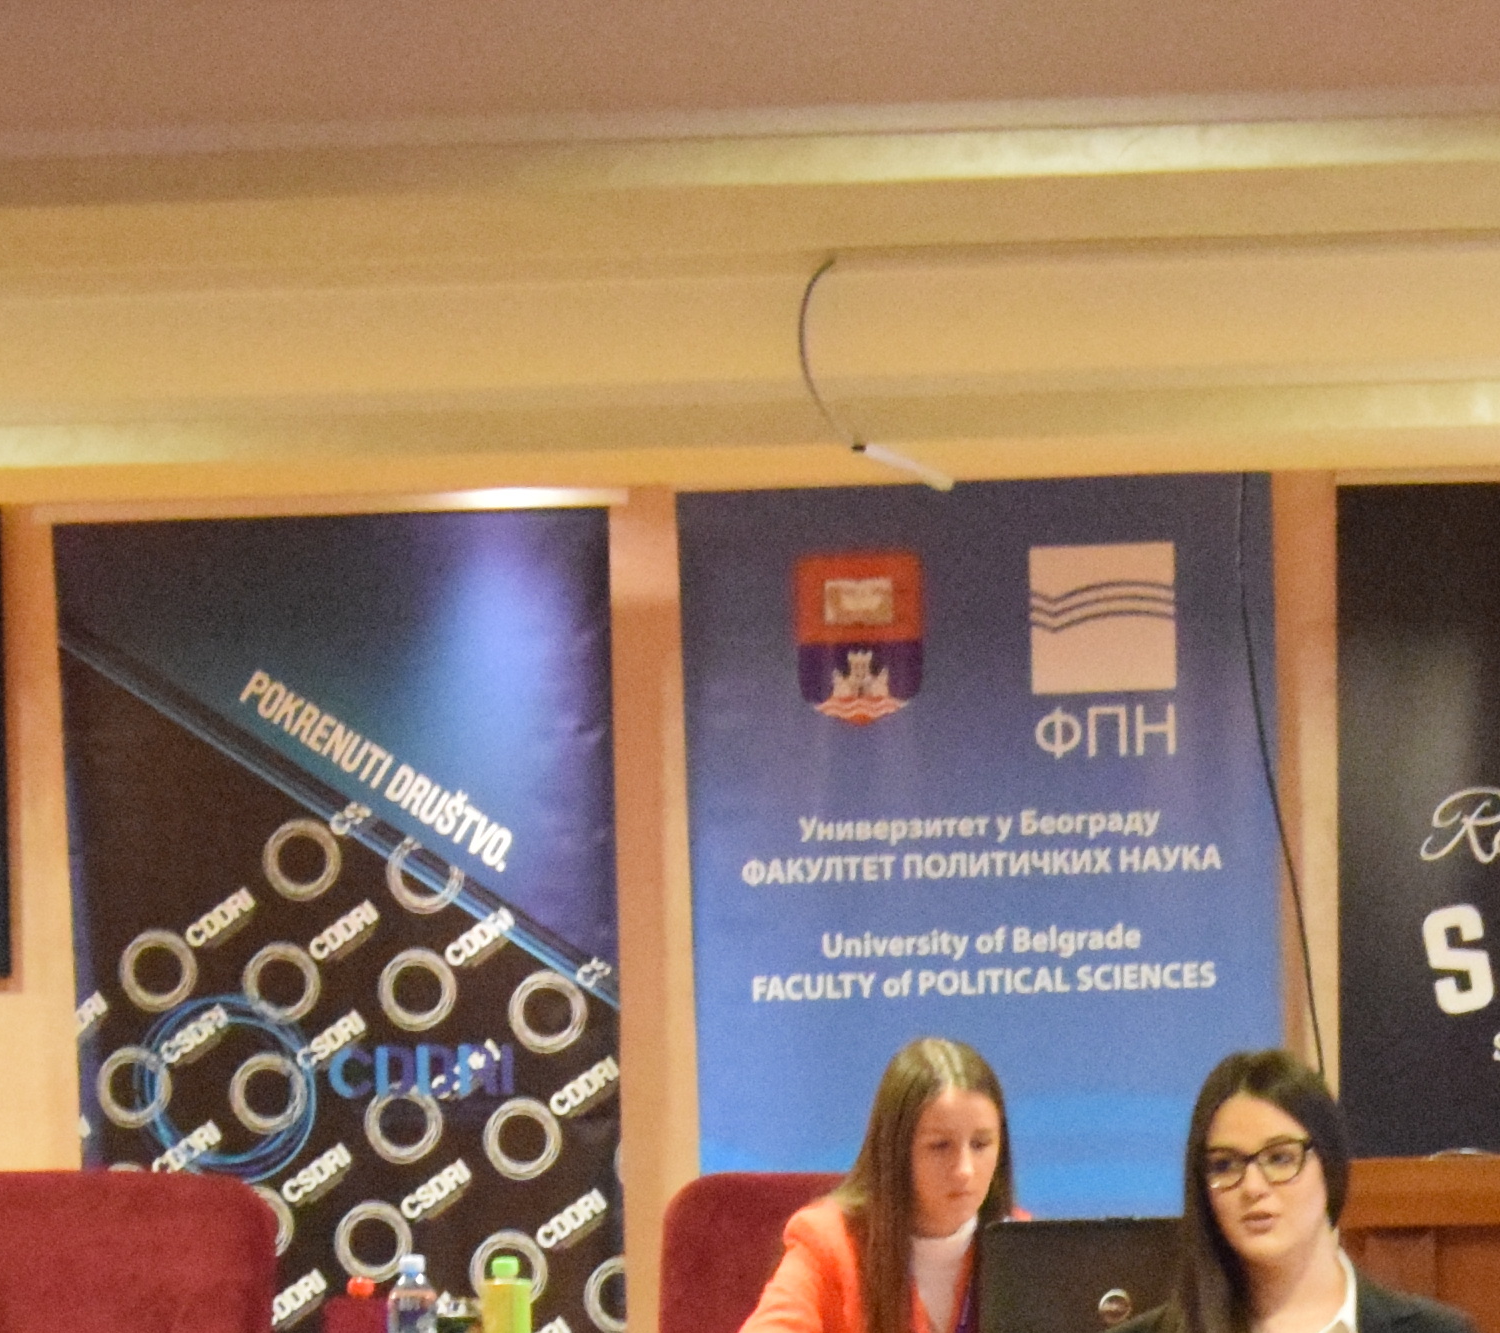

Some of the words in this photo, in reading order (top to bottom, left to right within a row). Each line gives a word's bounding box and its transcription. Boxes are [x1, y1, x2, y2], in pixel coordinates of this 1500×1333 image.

[1034, 703, 1177, 759] ФПН
[239, 669, 394, 789] POKRENUTI
[384, 763, 513, 873] DRUŠTVO.
[799, 816, 988, 847] Универзитет
[1020, 809, 1161, 839] Београду
[741, 854, 896, 887] ФАКУЛТЕТ
[903, 848, 1112, 880] ПОЛИТИЧКИХ
[1120, 844, 1223, 874] НАУКА
[821, 929, 969, 960] University
[976, 926, 1007, 954] of
[1013, 922, 1141, 958] Belgrade
[751, 972, 877, 1002] FACULTY
[883, 970, 913, 998] of
[919, 967, 1071, 998] POLITICAL
[1076, 961, 1218, 992] SCIENCES
